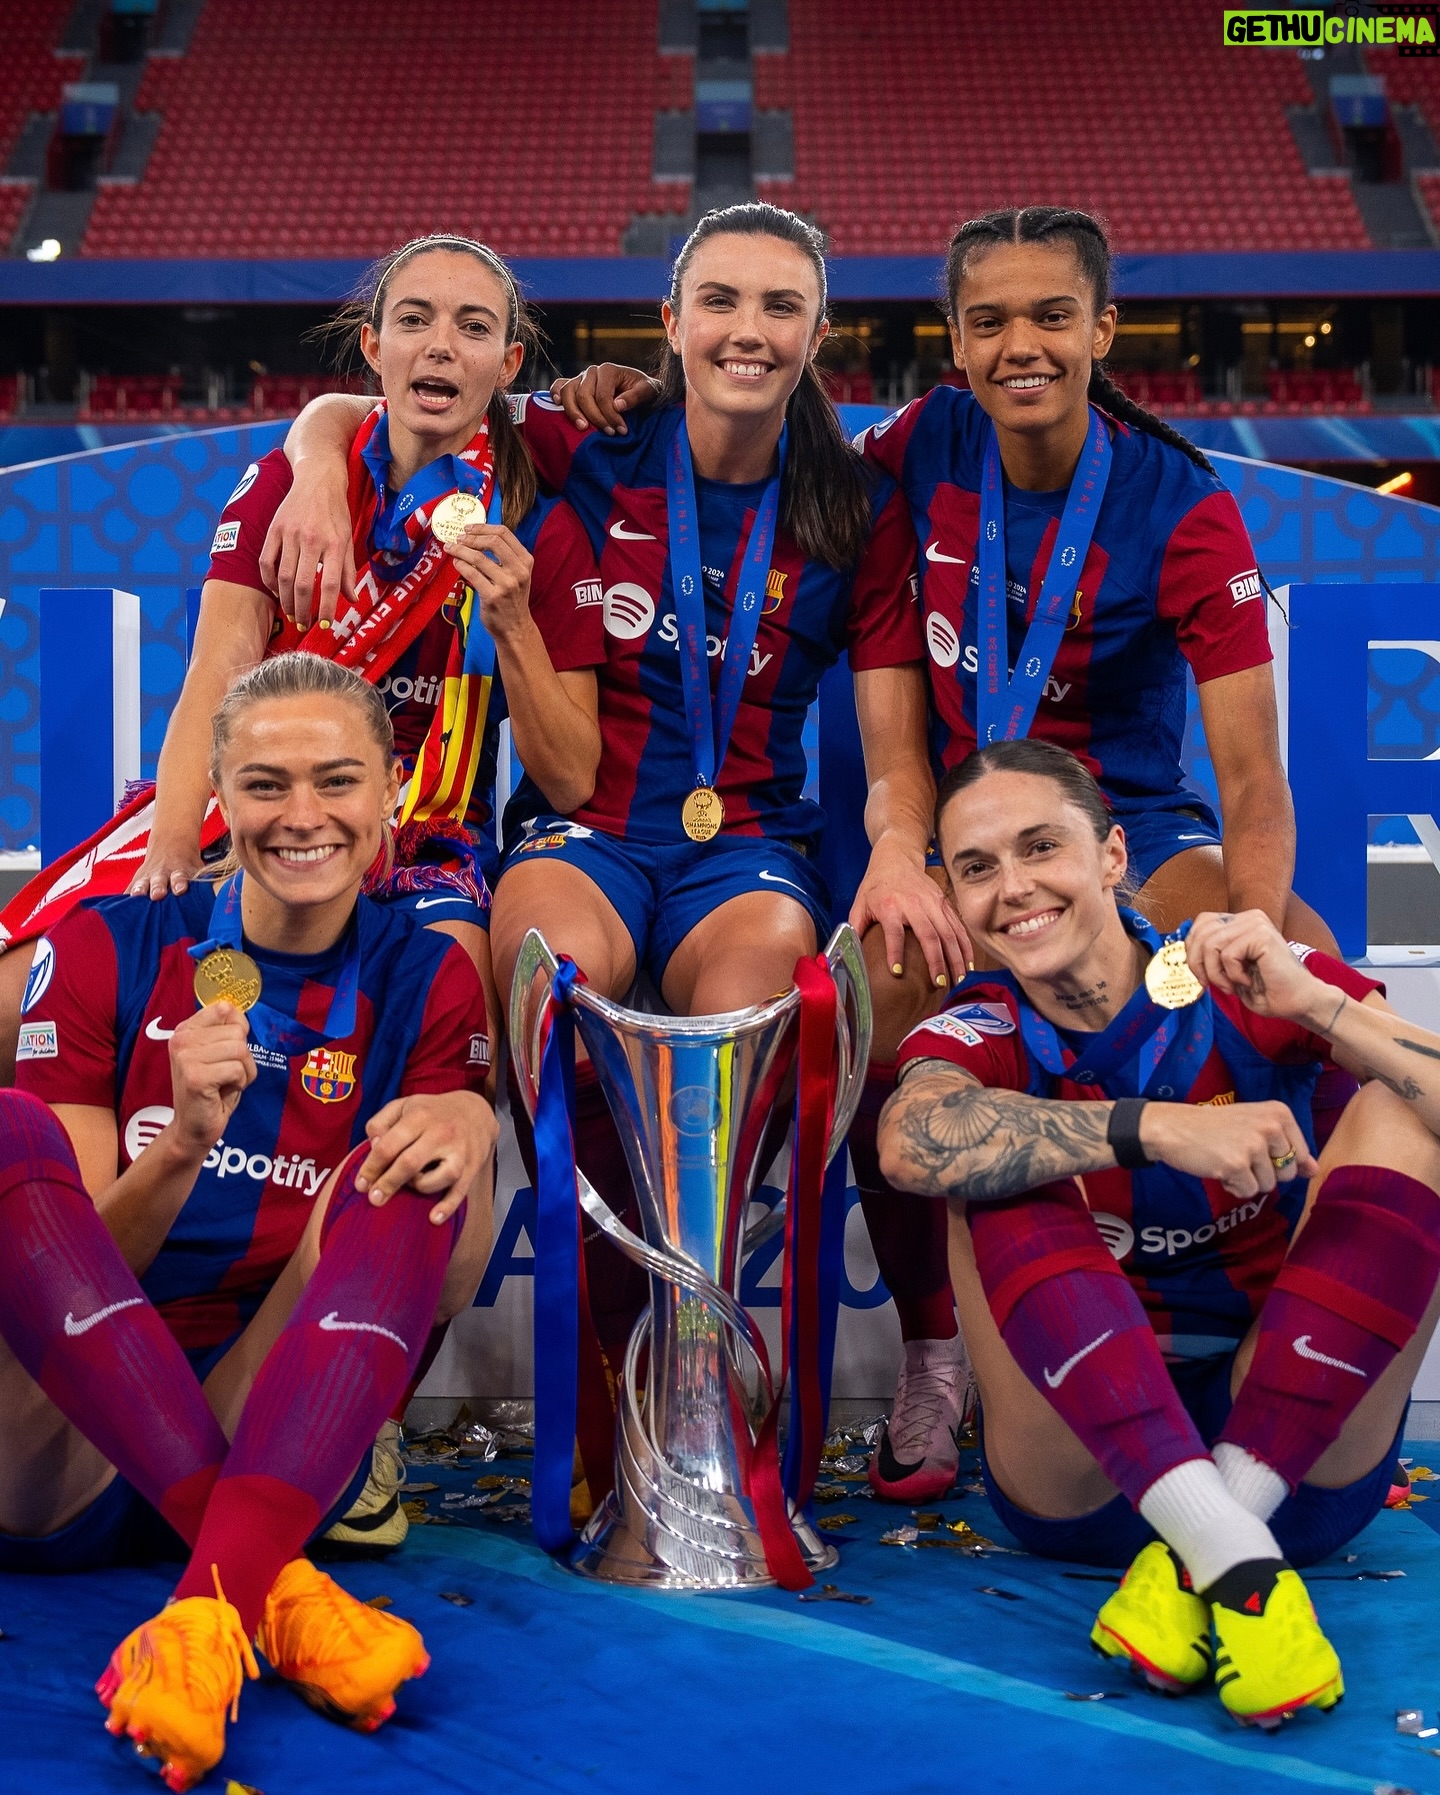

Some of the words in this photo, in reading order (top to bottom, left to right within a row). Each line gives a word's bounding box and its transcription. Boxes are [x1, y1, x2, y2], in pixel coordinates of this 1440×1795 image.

[393, 540, 443, 602] AGUE
[707, 567, 725, 578] 2024
[987, 572, 997, 630] FINAL
[340, 603, 393, 656] FINA
[375, 674, 446, 706] otif
[1140, 1193, 1269, 1257] Spotify
